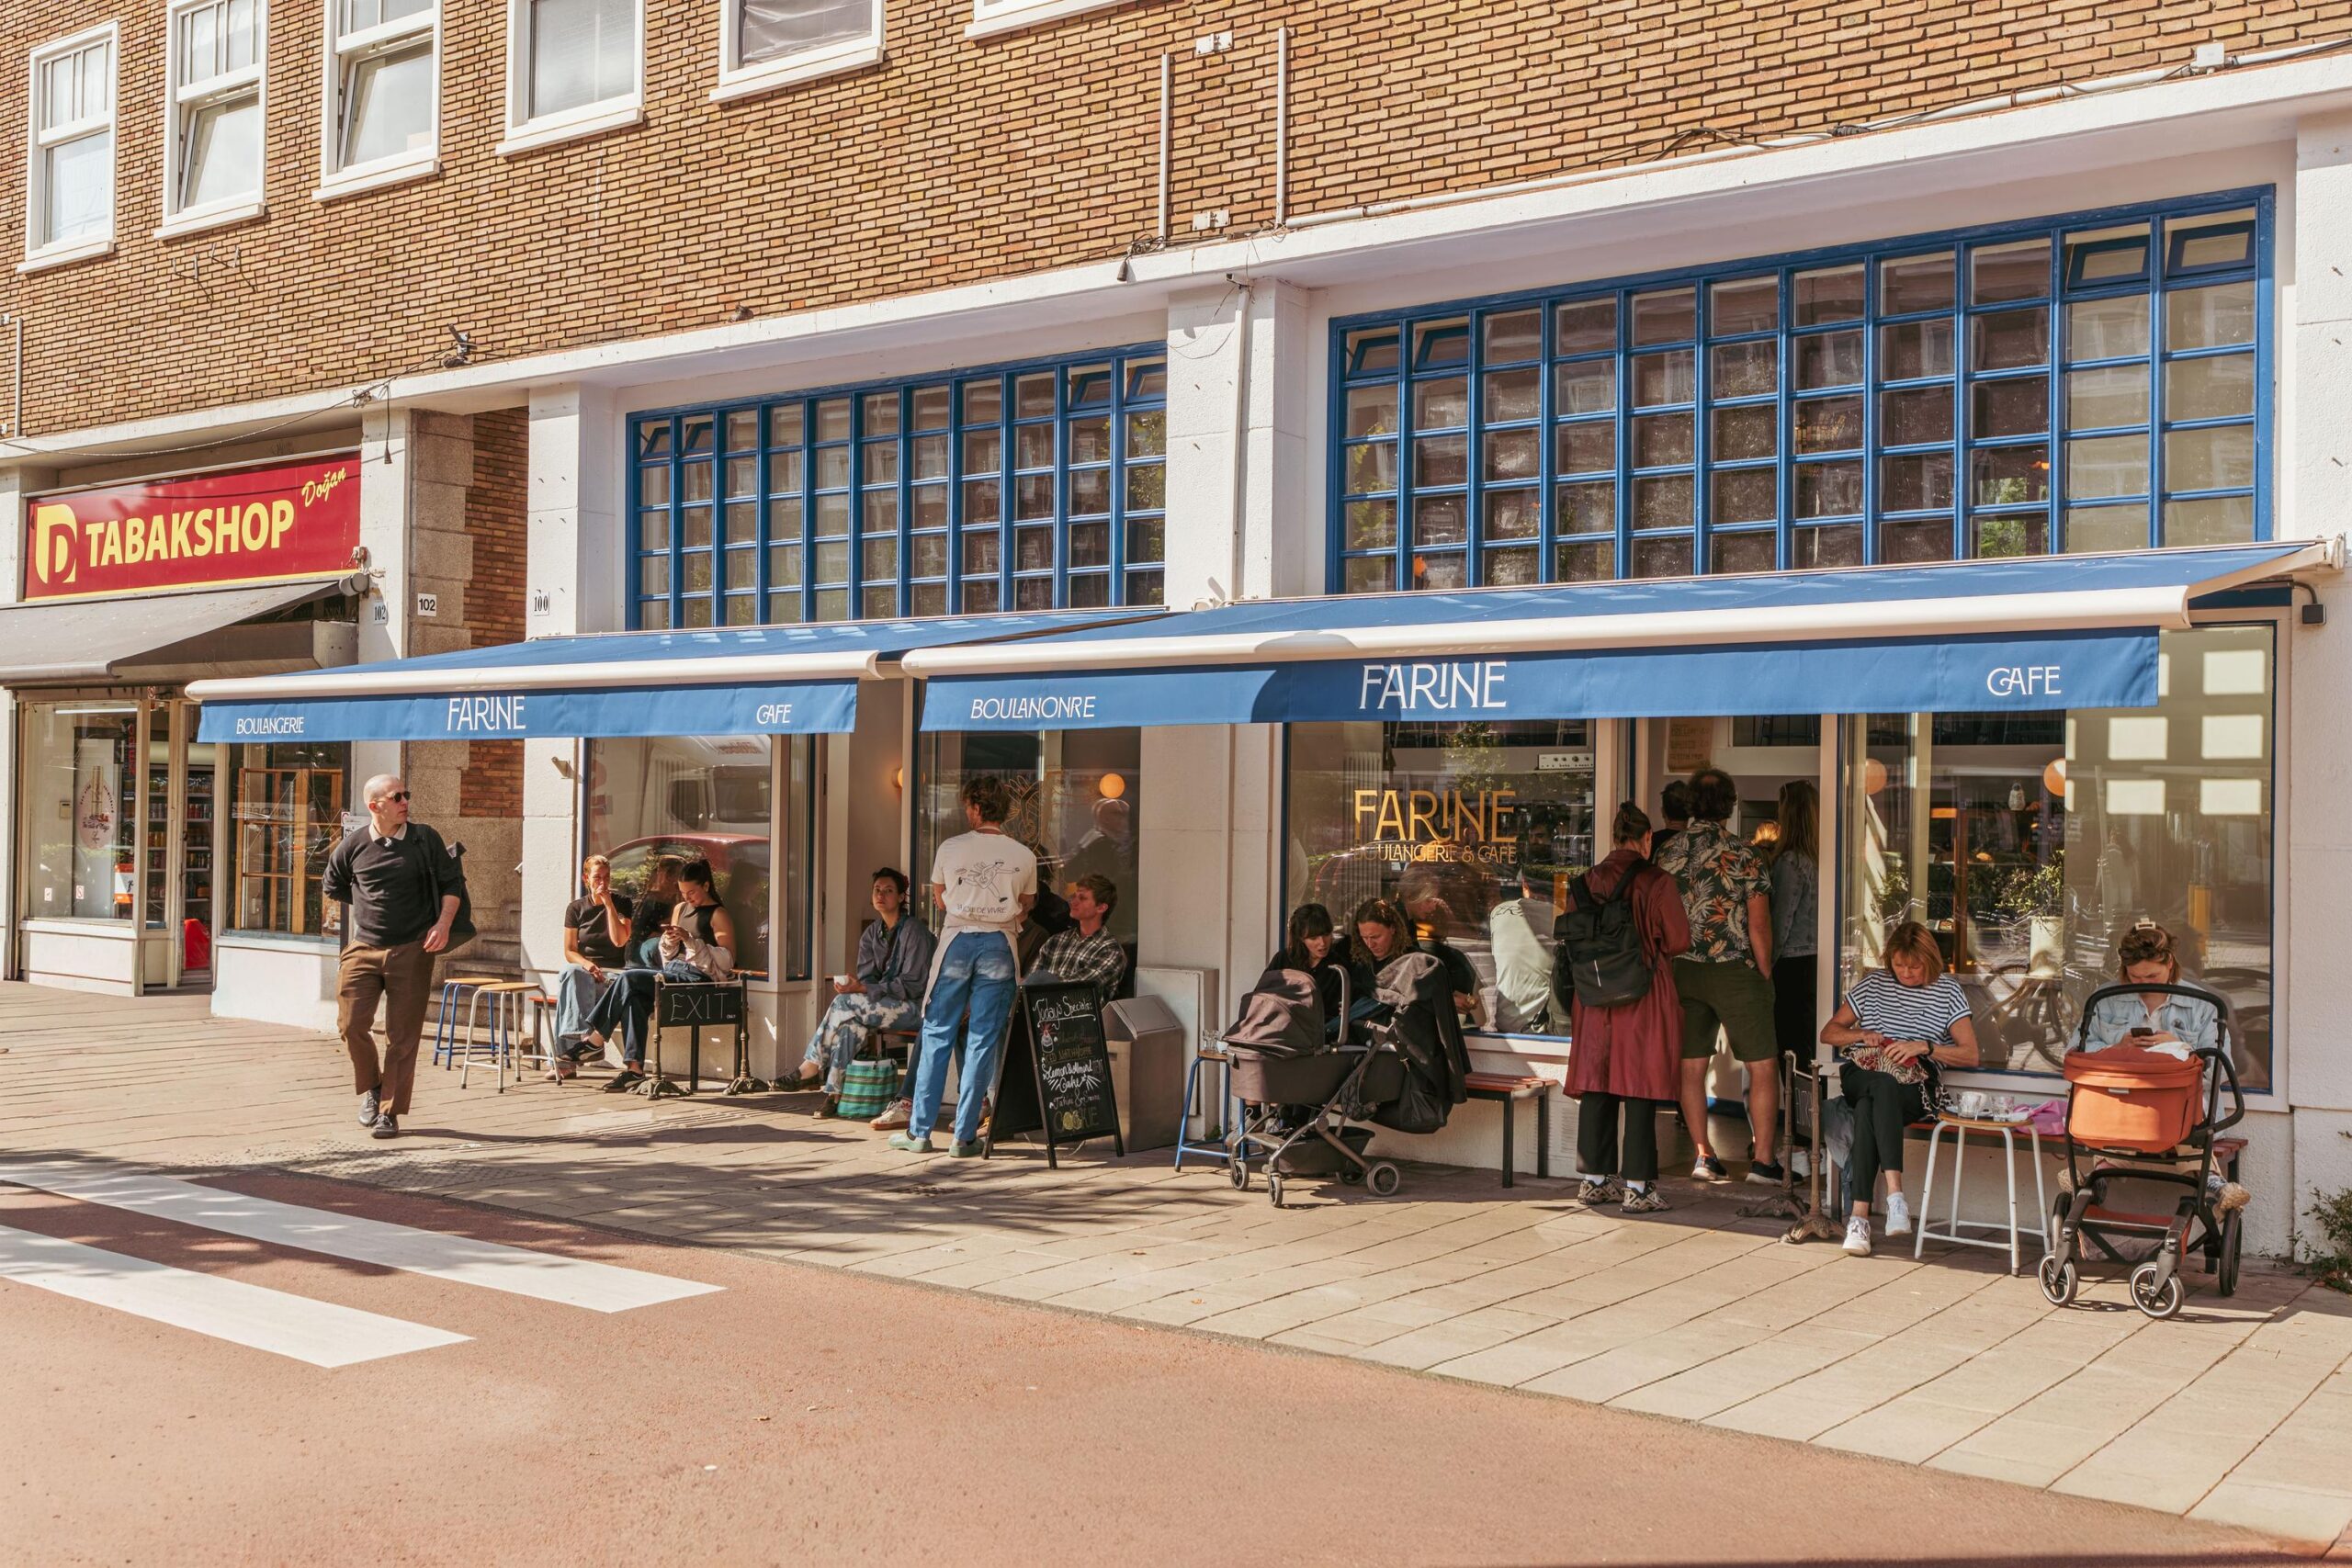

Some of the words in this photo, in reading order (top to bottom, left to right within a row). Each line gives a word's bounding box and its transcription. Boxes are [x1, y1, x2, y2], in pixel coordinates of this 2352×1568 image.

[301, 467, 346, 507] Doğan
[85, 499, 295, 568] TABAKSHOP
[374, 605, 387, 621] 102
[419, 598, 435, 612] 102
[534, 595, 548, 612] 100
[1359, 660, 1508, 709] FARINE
[1986, 666, 2062, 696] CAFE
[236, 716, 305, 735] BOULANGERIE
[447, 695, 526, 731] FARINE
[756, 704, 793, 726] CAFE
[1354, 789, 1518, 843] FARINE
[1462, 844, 1475, 863] &
[1477, 844, 1518, 865] CAFE
[670, 992, 729, 1022] EXIT
